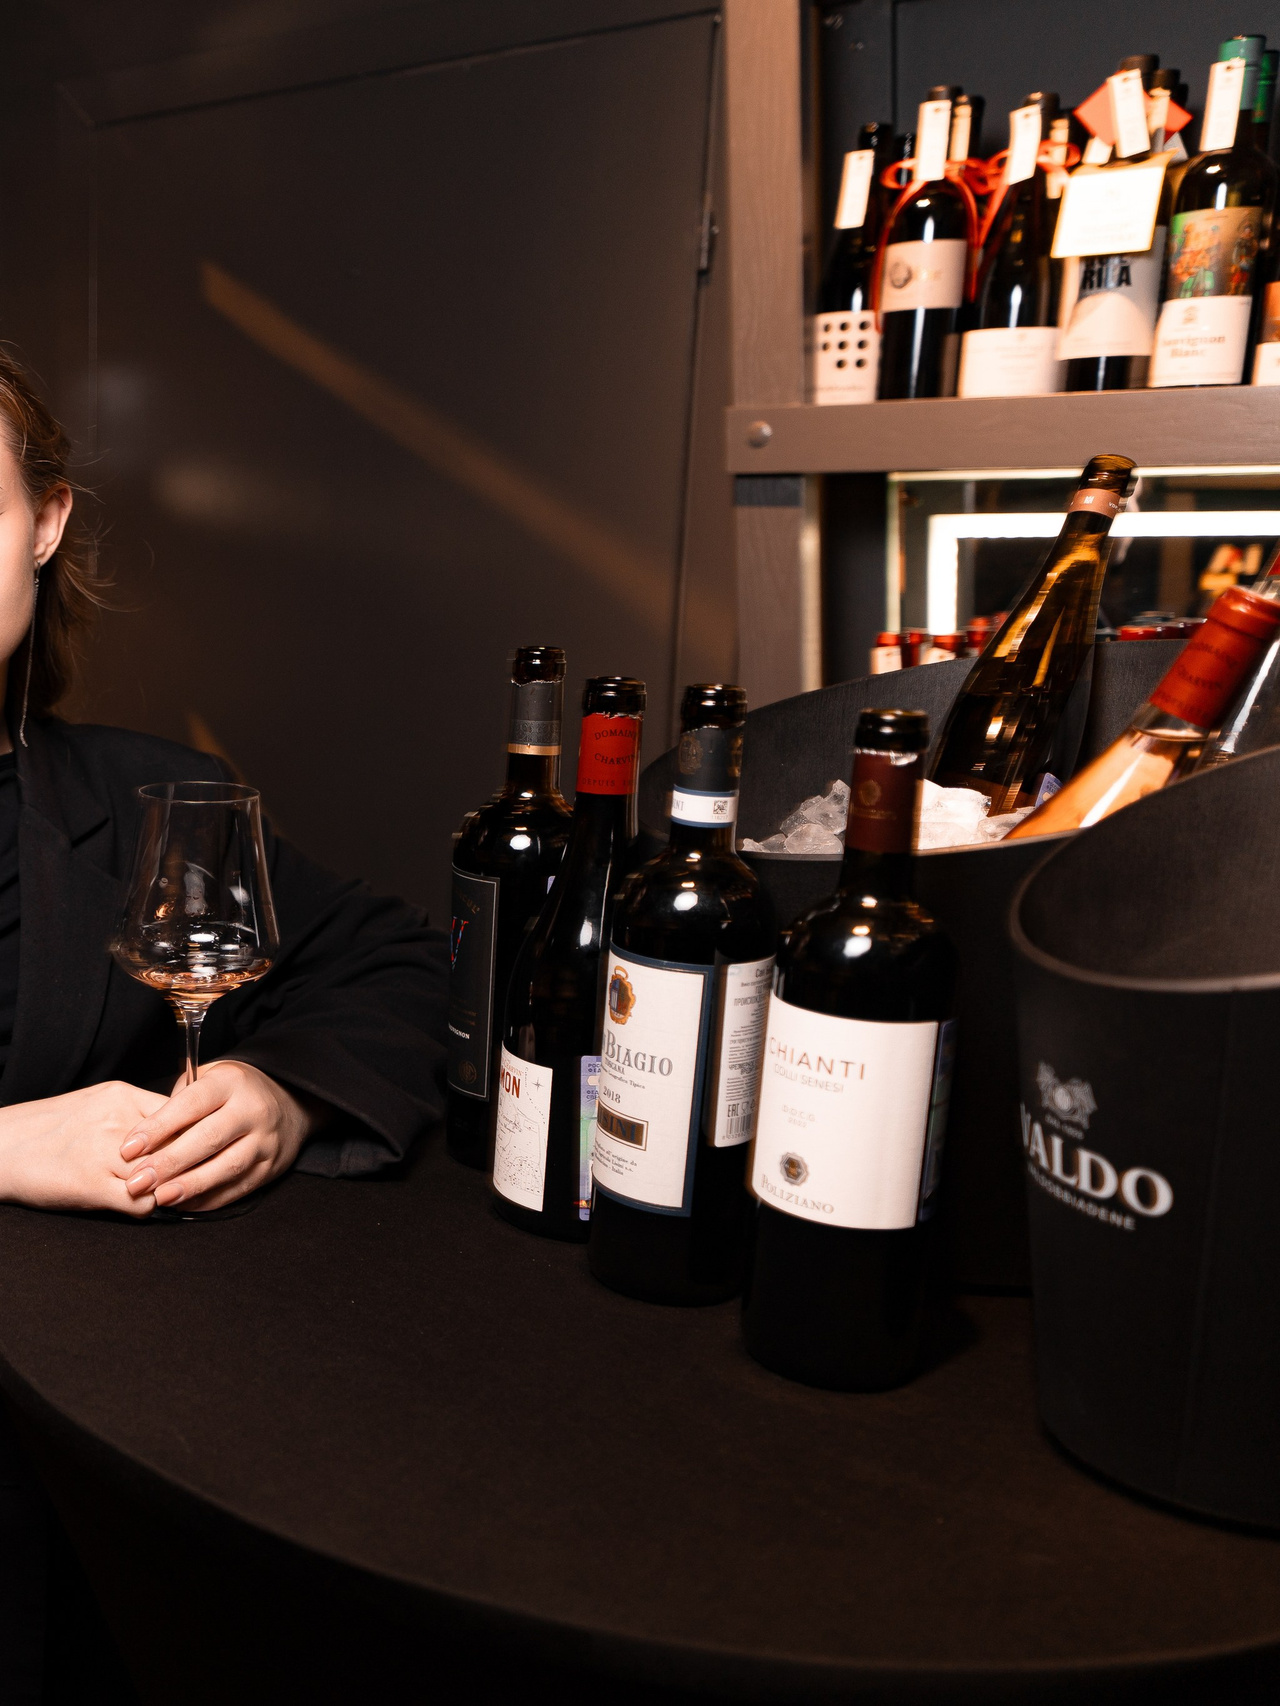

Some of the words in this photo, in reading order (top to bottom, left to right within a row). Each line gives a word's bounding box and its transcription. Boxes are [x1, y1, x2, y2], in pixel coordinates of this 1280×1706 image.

[606, 1028, 674, 1077] BIAGIO
[769, 1036, 865, 1080] CHIANTI
[603, 1085, 621, 1104] 2018
[801, 1074, 844, 1094] SENESI
[1020, 1101, 1175, 1219] VALDO
[761, 1173, 835, 1215] POLIZIANO
